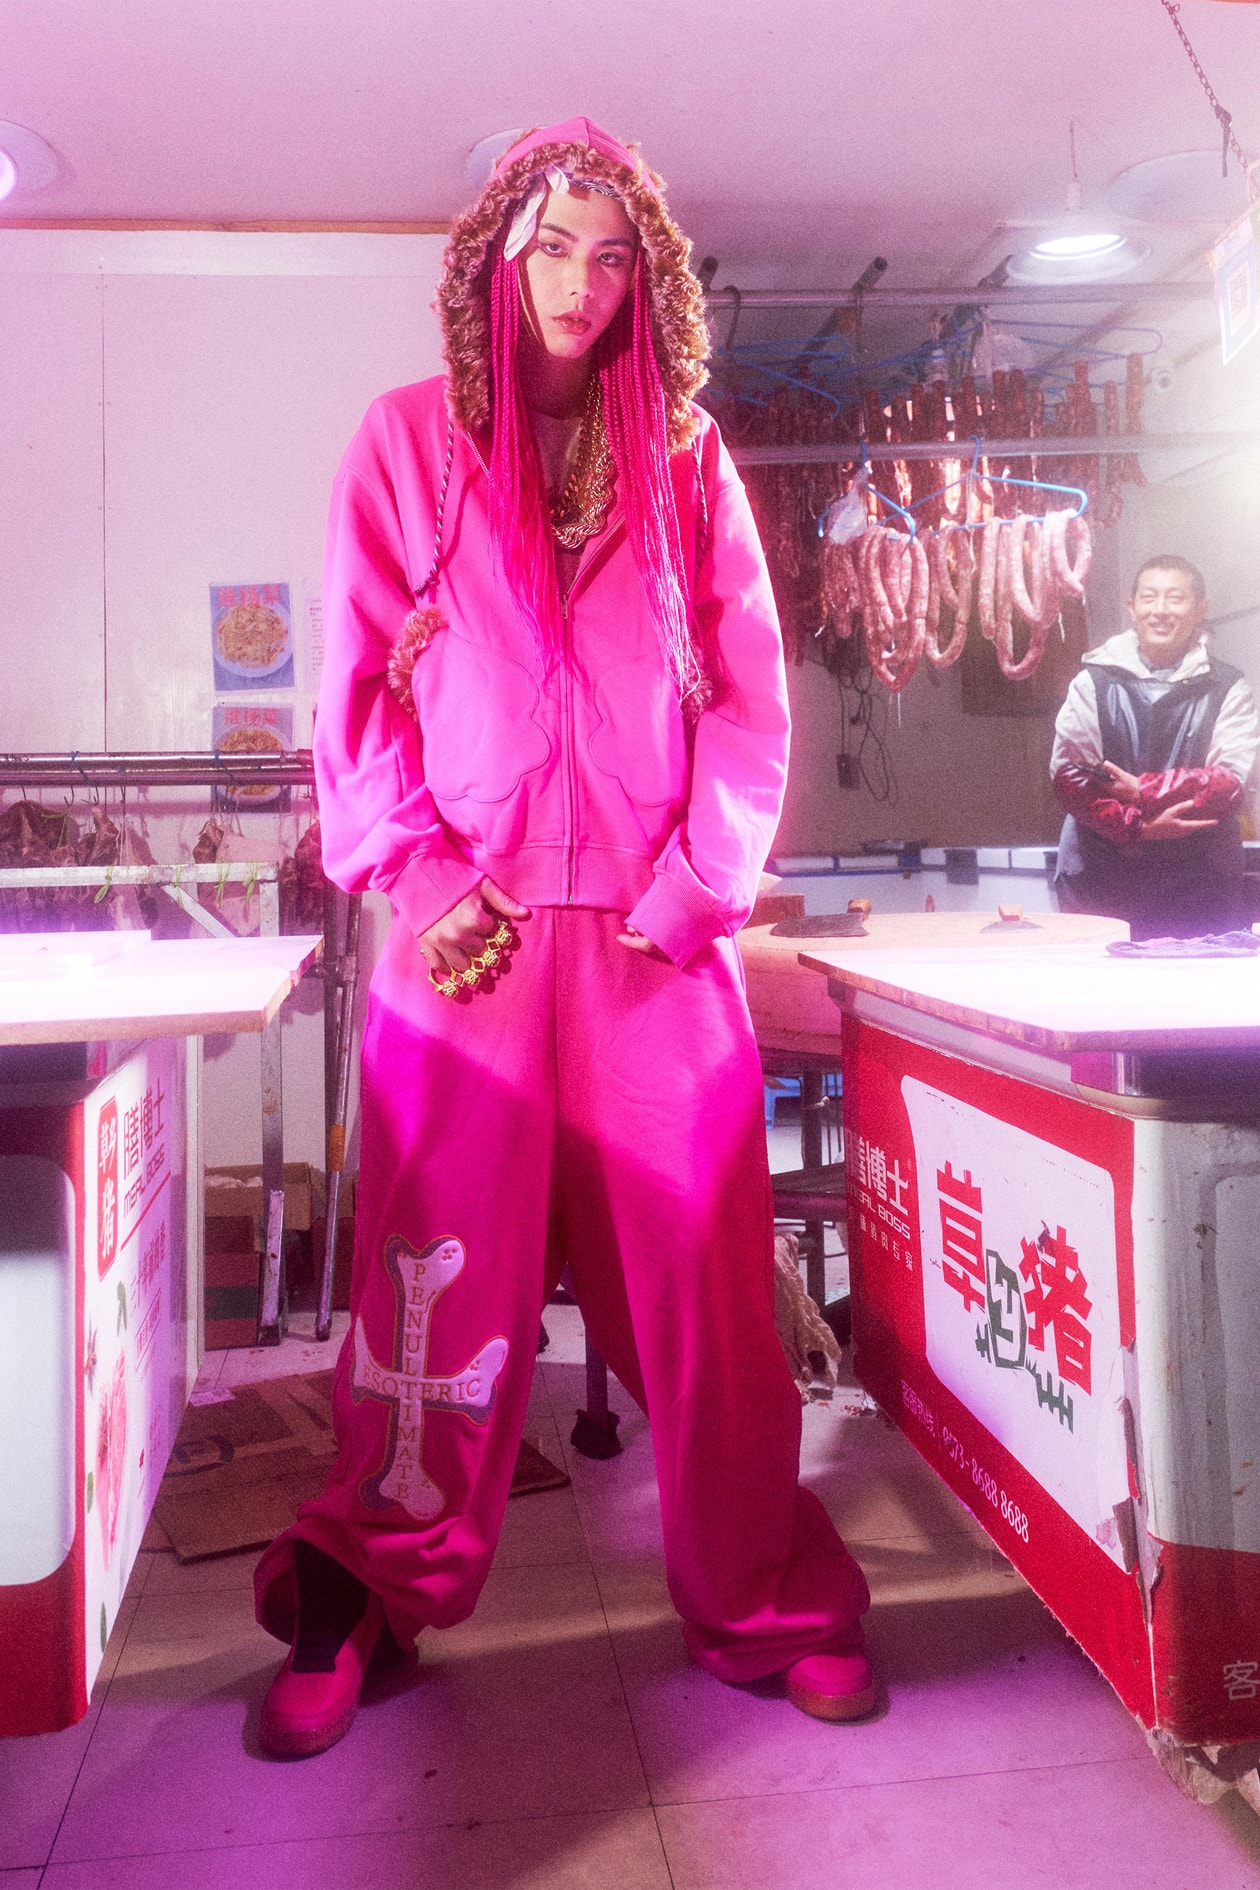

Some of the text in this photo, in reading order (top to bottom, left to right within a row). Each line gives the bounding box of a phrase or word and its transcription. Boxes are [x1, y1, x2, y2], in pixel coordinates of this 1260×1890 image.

[124, 1079, 164, 1180] 膳博士
[878, 1203, 910, 1240] BOSS
[362, 1364, 481, 1402] ESOTERIC
[397, 1262, 426, 1500] PENULTIMATE
[1001, 1491, 1029, 1543] 8688
